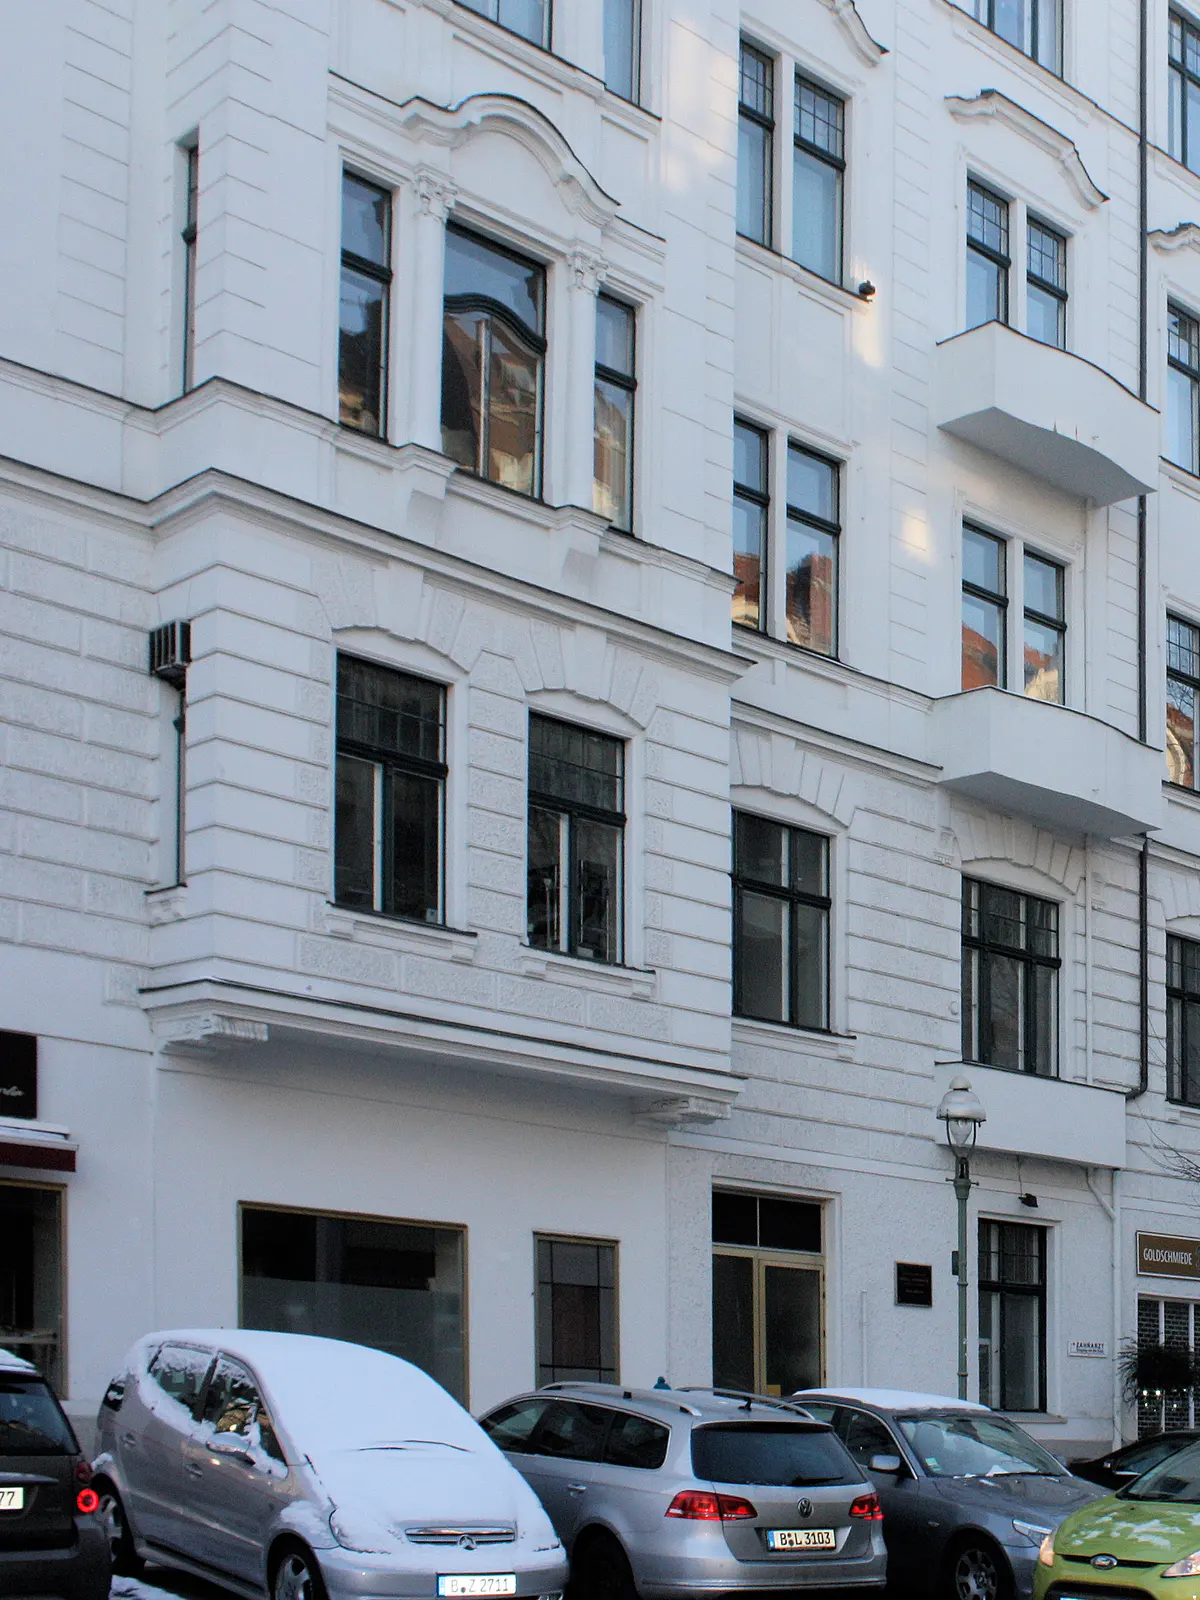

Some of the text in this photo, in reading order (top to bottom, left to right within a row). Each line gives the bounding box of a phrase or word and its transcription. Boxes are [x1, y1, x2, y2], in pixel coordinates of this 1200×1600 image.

[1143, 1247, 1193, 1266] GOLDSCHMIEDE
[780, 1531, 831, 1546] B L 3103
[451, 1578, 508, 1593] B Z 2711
